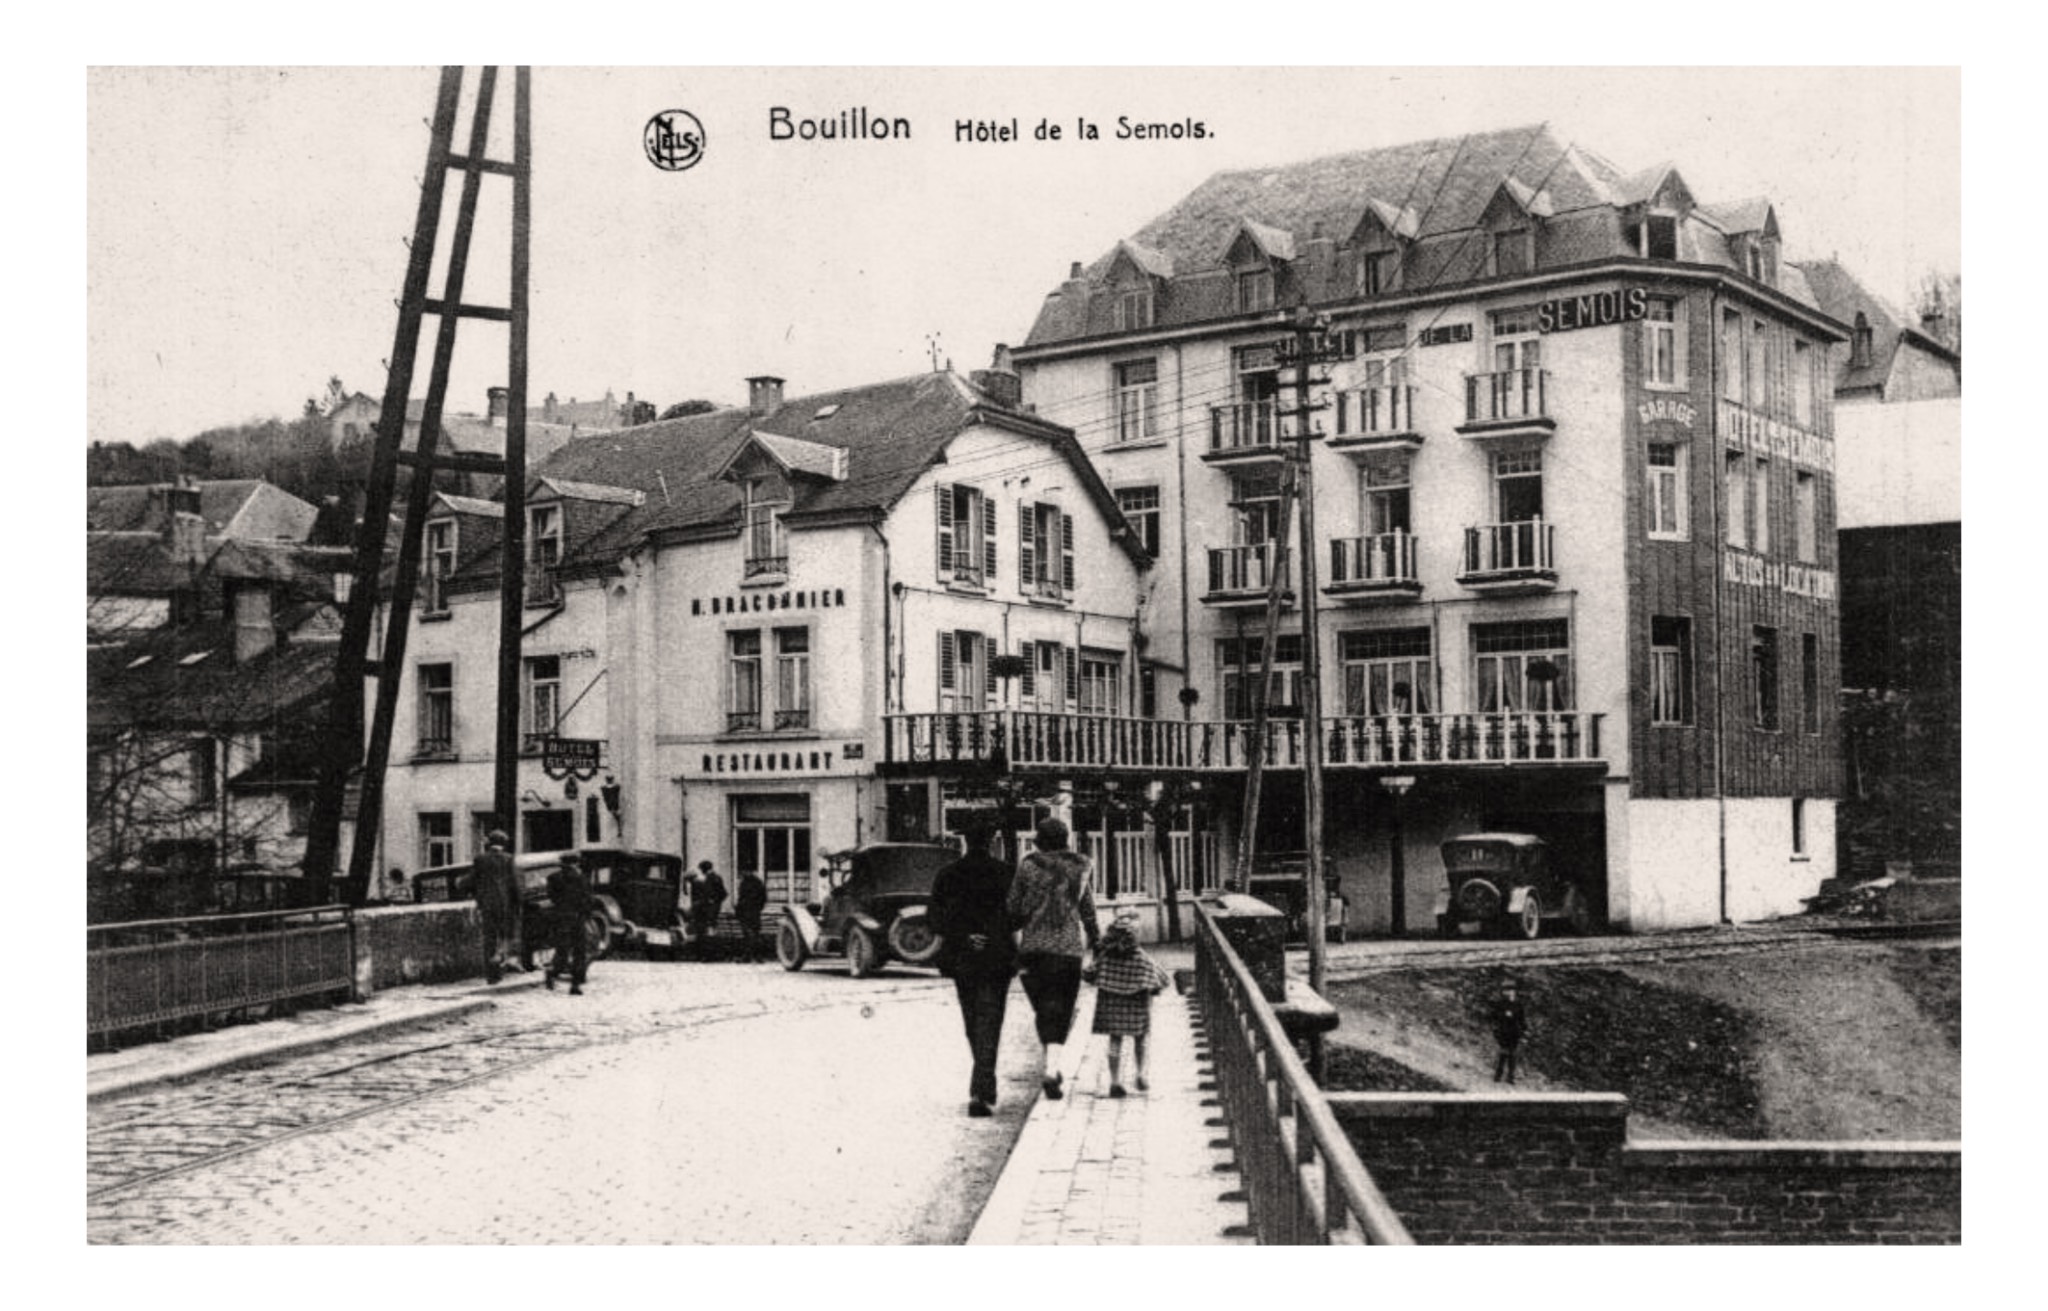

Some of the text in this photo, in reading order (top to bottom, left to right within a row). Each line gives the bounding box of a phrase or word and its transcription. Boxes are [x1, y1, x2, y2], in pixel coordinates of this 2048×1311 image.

[1538, 288, 1648, 333] SEMOIS
[1638, 399, 1698, 428] GARAGE
[712, 588, 845, 616] BRACONNIER
[702, 752, 833, 773] RESTAURANT
